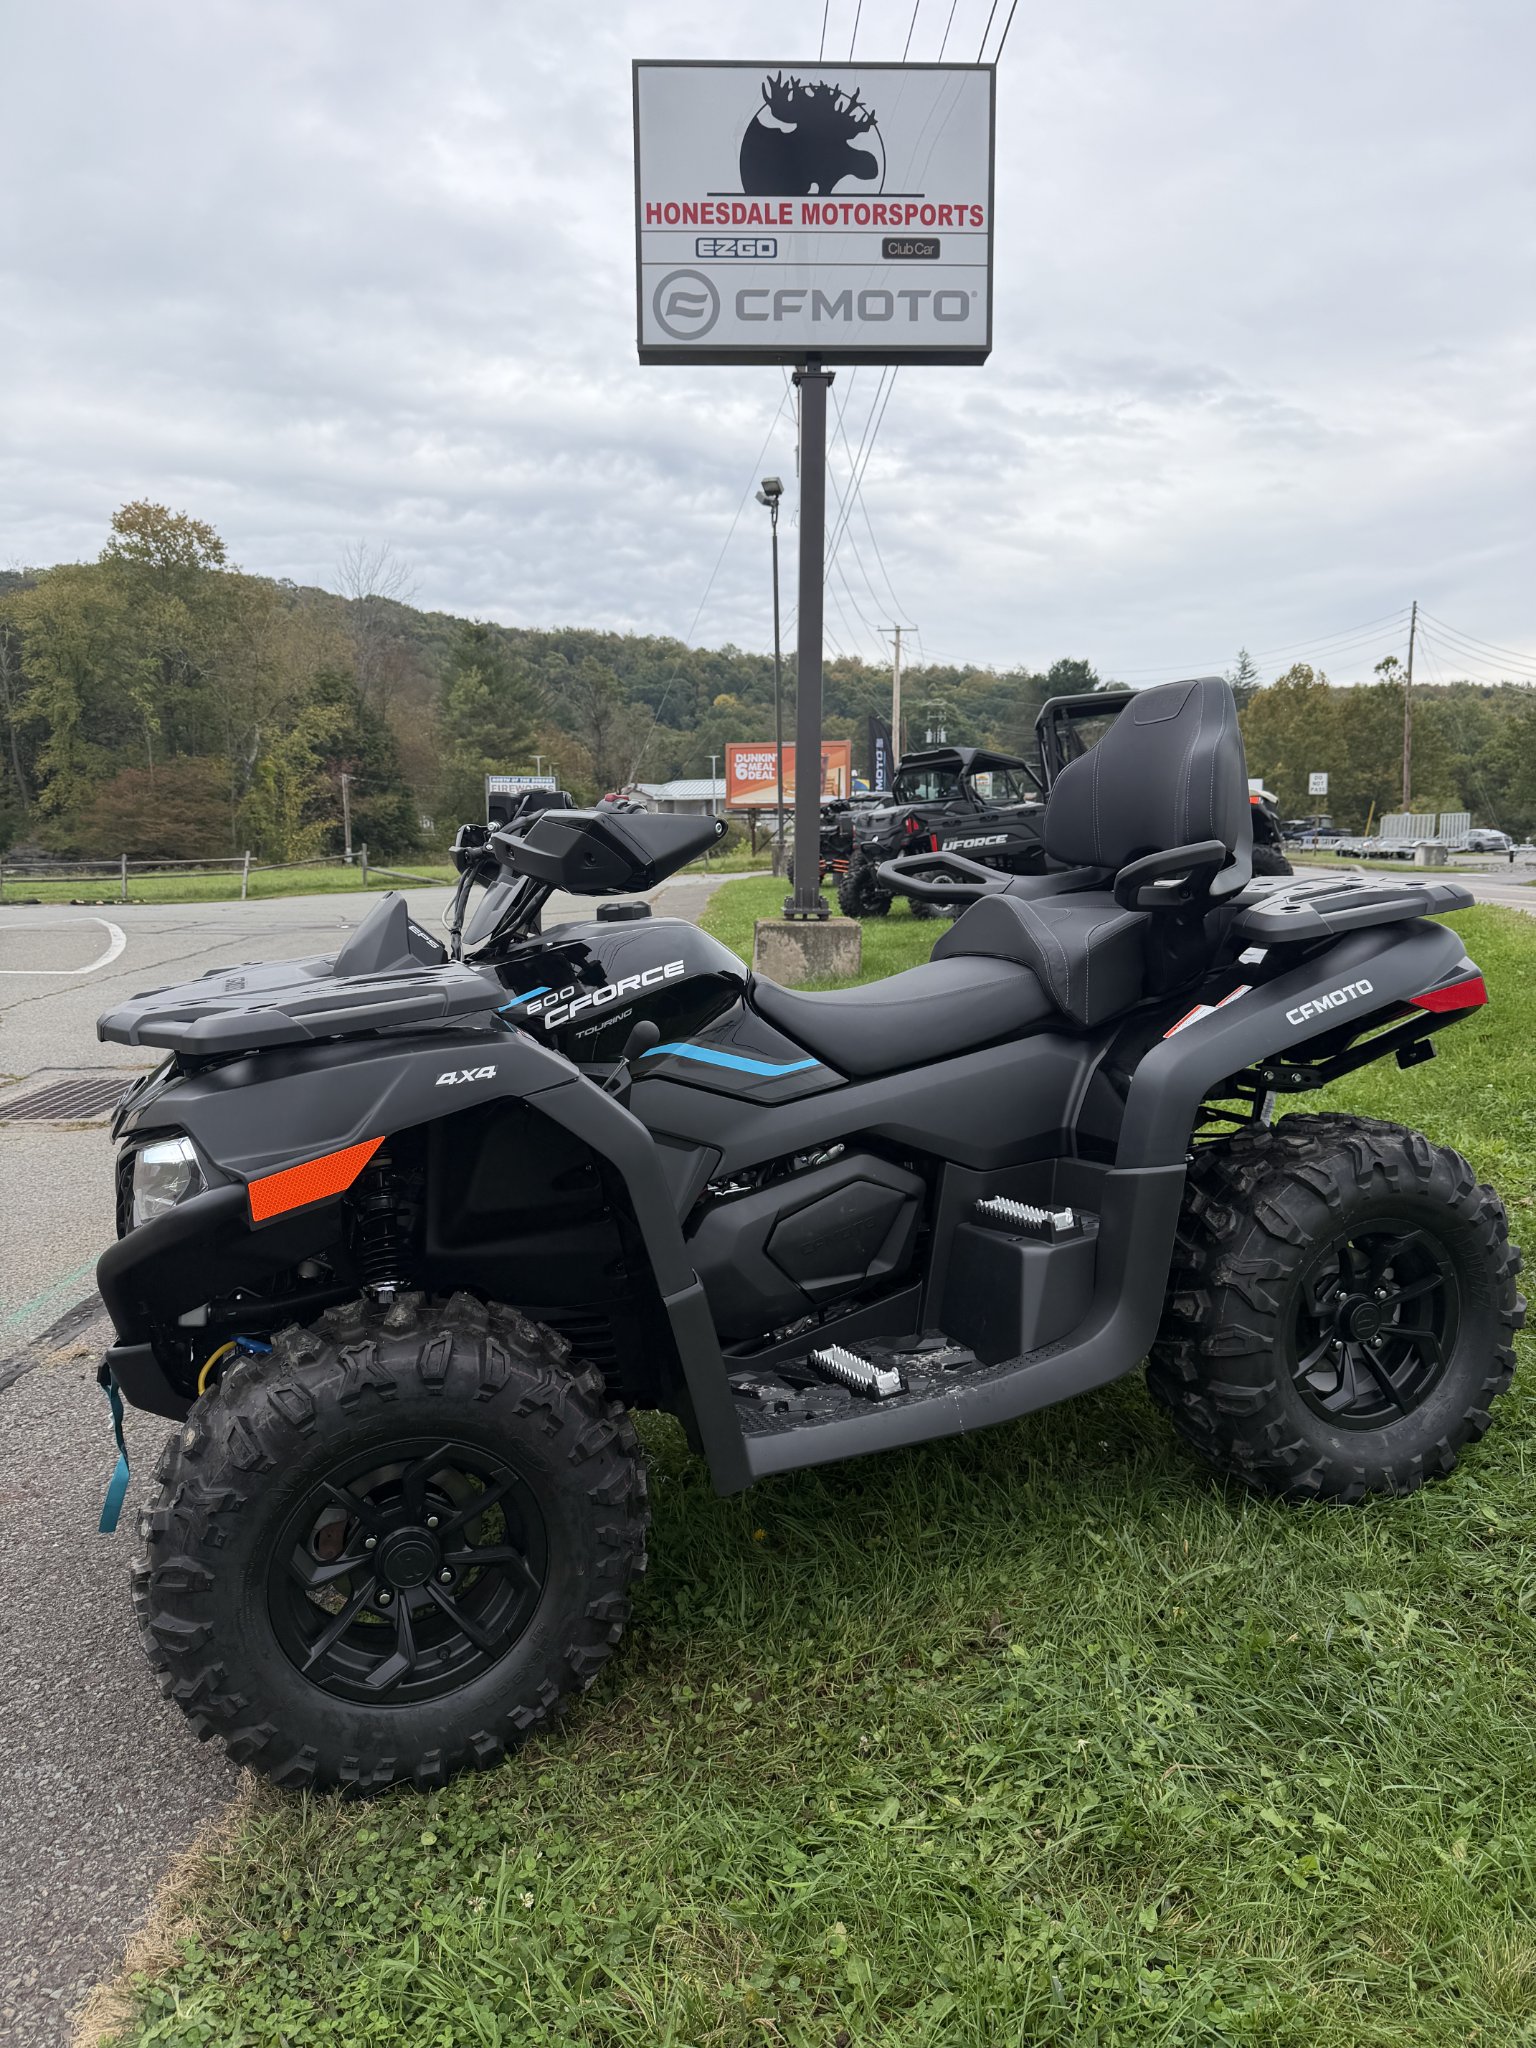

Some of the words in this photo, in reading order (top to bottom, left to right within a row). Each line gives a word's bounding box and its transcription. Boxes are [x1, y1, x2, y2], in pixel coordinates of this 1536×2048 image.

[646, 202, 793, 225] HONESDALE
[801, 203, 984, 227] MOTORSPORTS
[697, 239, 776, 257] EZGO
[888, 242, 913, 255] Club
[914, 242, 935, 255] Car
[735, 289, 970, 322] CFMOTO
[736, 753, 777, 762] DUNKIN'
[748, 762, 775, 771] MEAL
[748, 771, 775, 780] DEAL
[941, 834, 1008, 851] UFORCE
[408, 925, 440, 949] EPS
[527, 985, 575, 1015] 600
[544, 959, 685, 1030] CFORCE
[1285, 979, 1374, 1025] CFMOTO
[575, 1008, 633, 1039] TOURING
